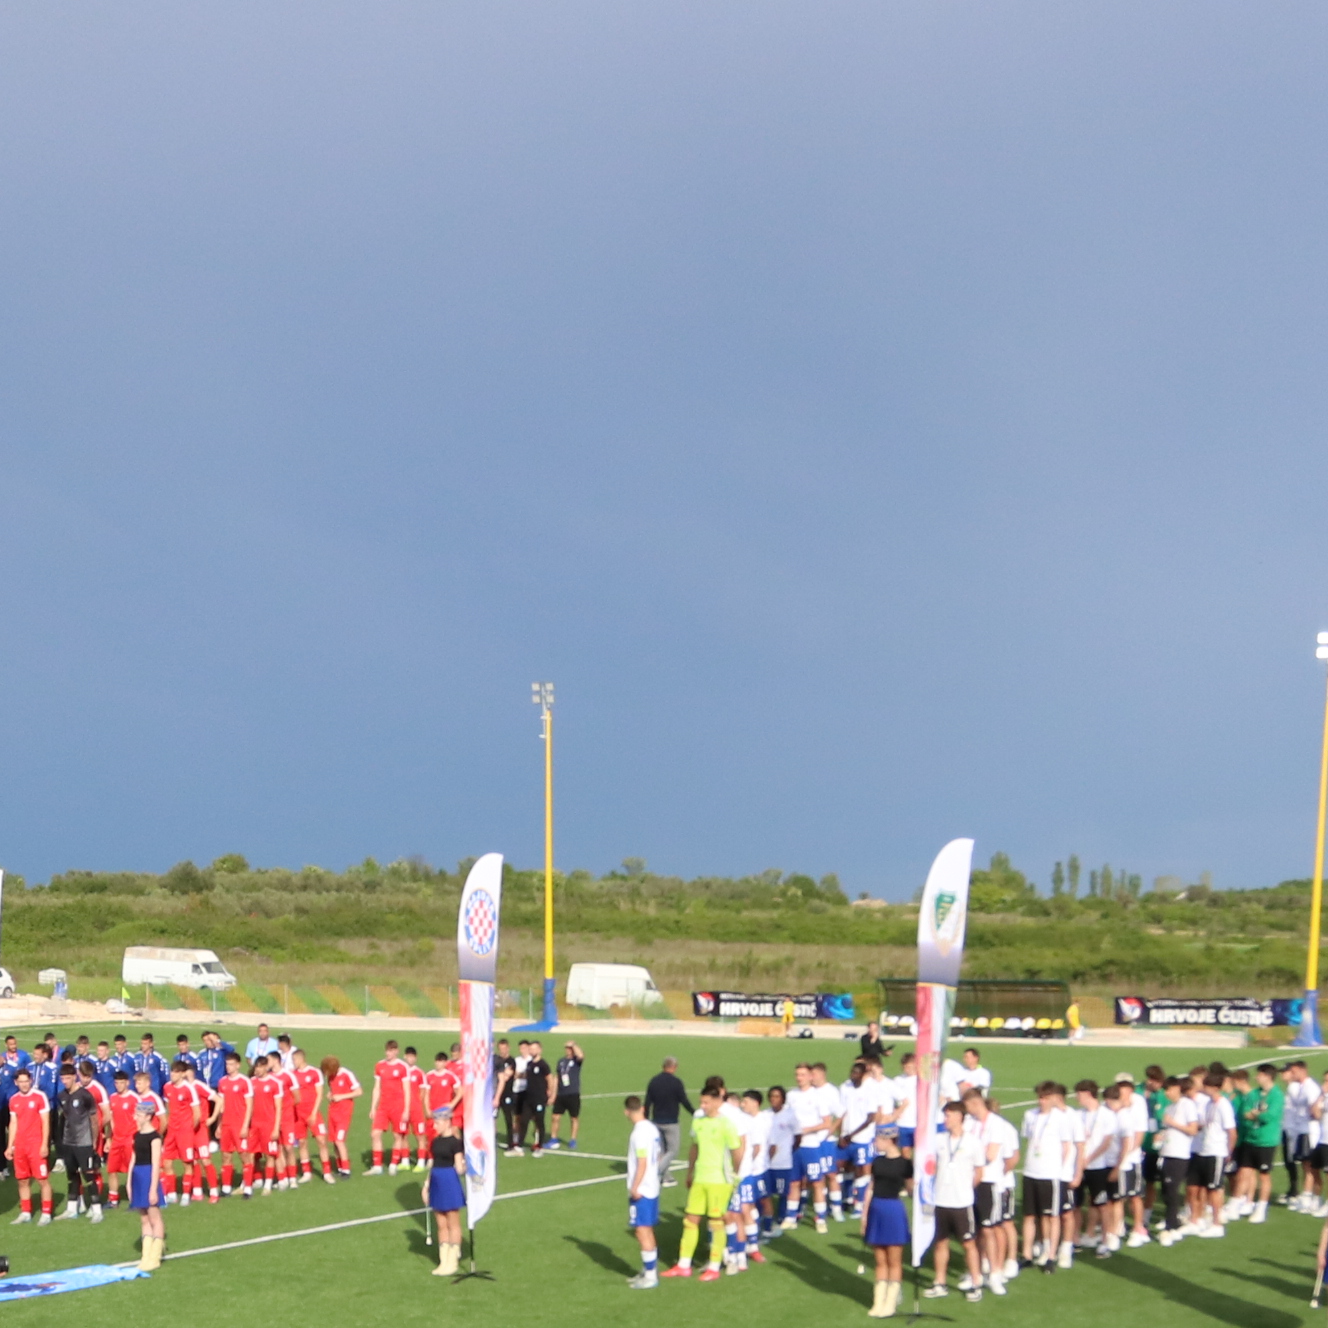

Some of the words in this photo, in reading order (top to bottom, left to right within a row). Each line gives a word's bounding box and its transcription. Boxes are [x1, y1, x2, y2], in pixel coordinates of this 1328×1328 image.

[719, 1002, 773, 1016] HRVOJE
[775, 1001, 817, 1017] ČSTIĆ
[1149, 1009, 1216, 1024] HRVOJE
